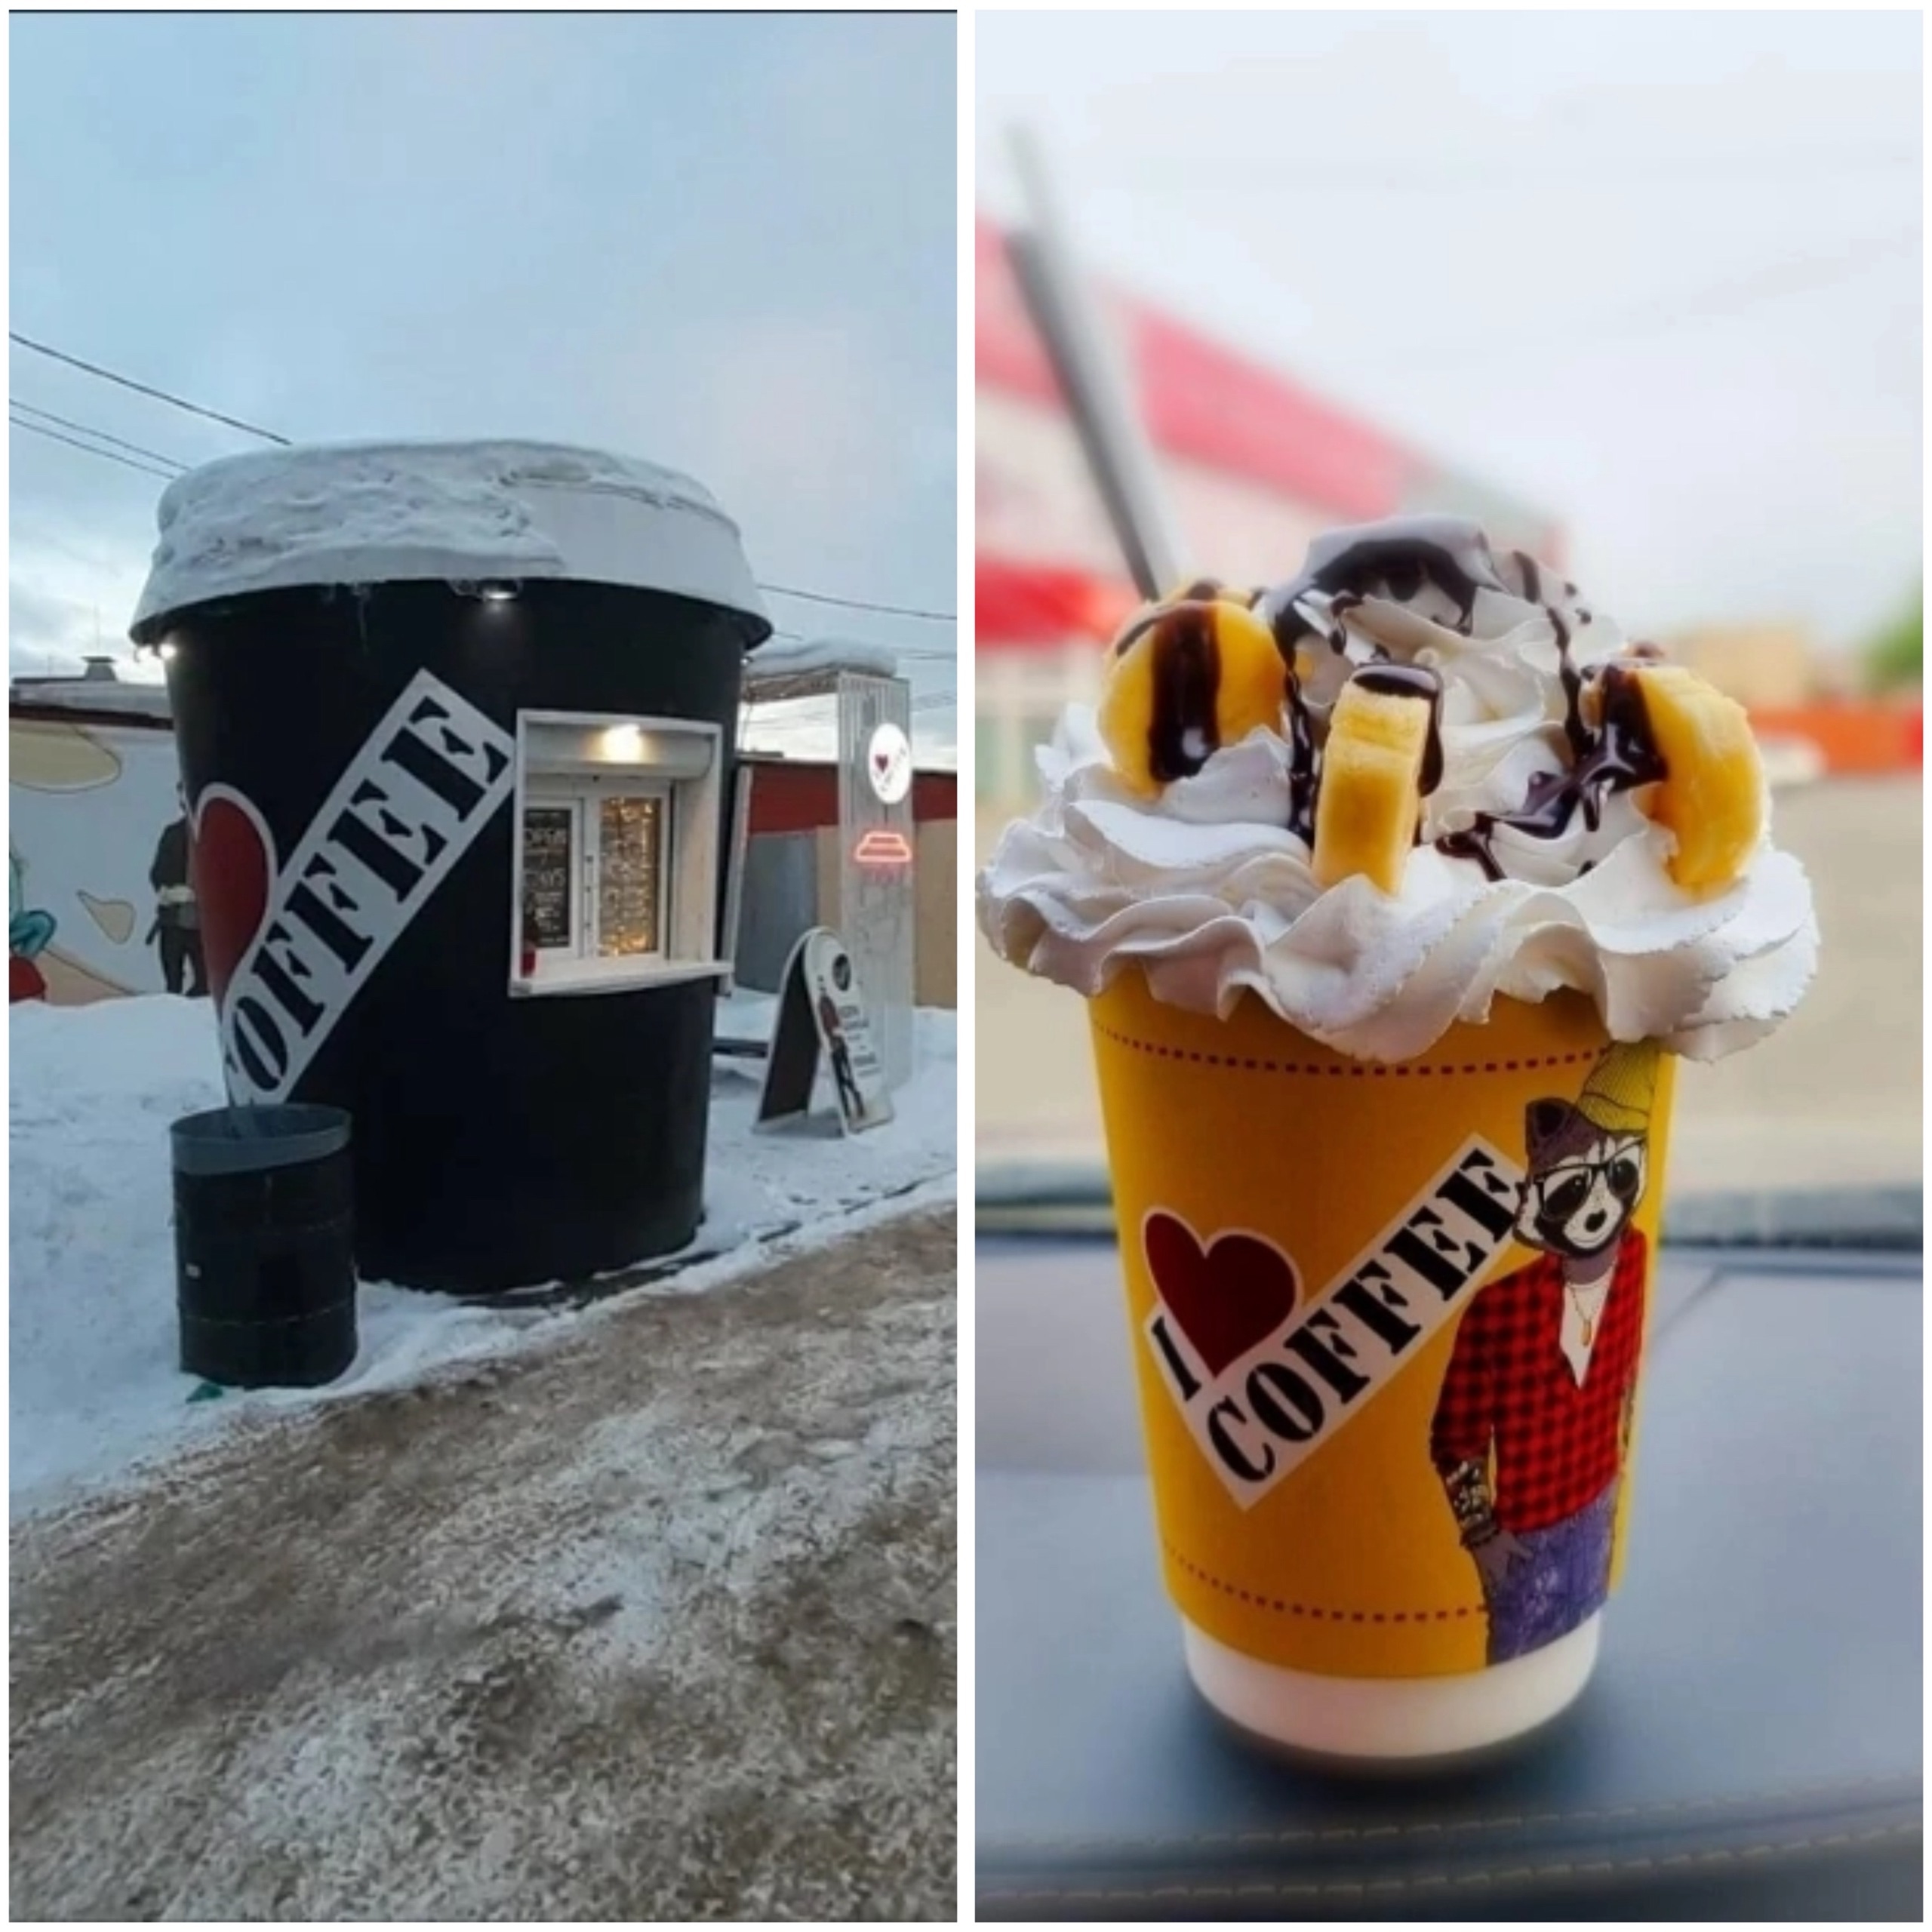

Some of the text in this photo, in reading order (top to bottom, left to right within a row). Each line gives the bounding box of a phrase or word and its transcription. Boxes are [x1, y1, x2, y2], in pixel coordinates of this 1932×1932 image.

[226, 696, 509, 1104] OFFEE
[1151, 1315, 1201, 1401] I
[1208, 1148, 1523, 1481] COFFEE
